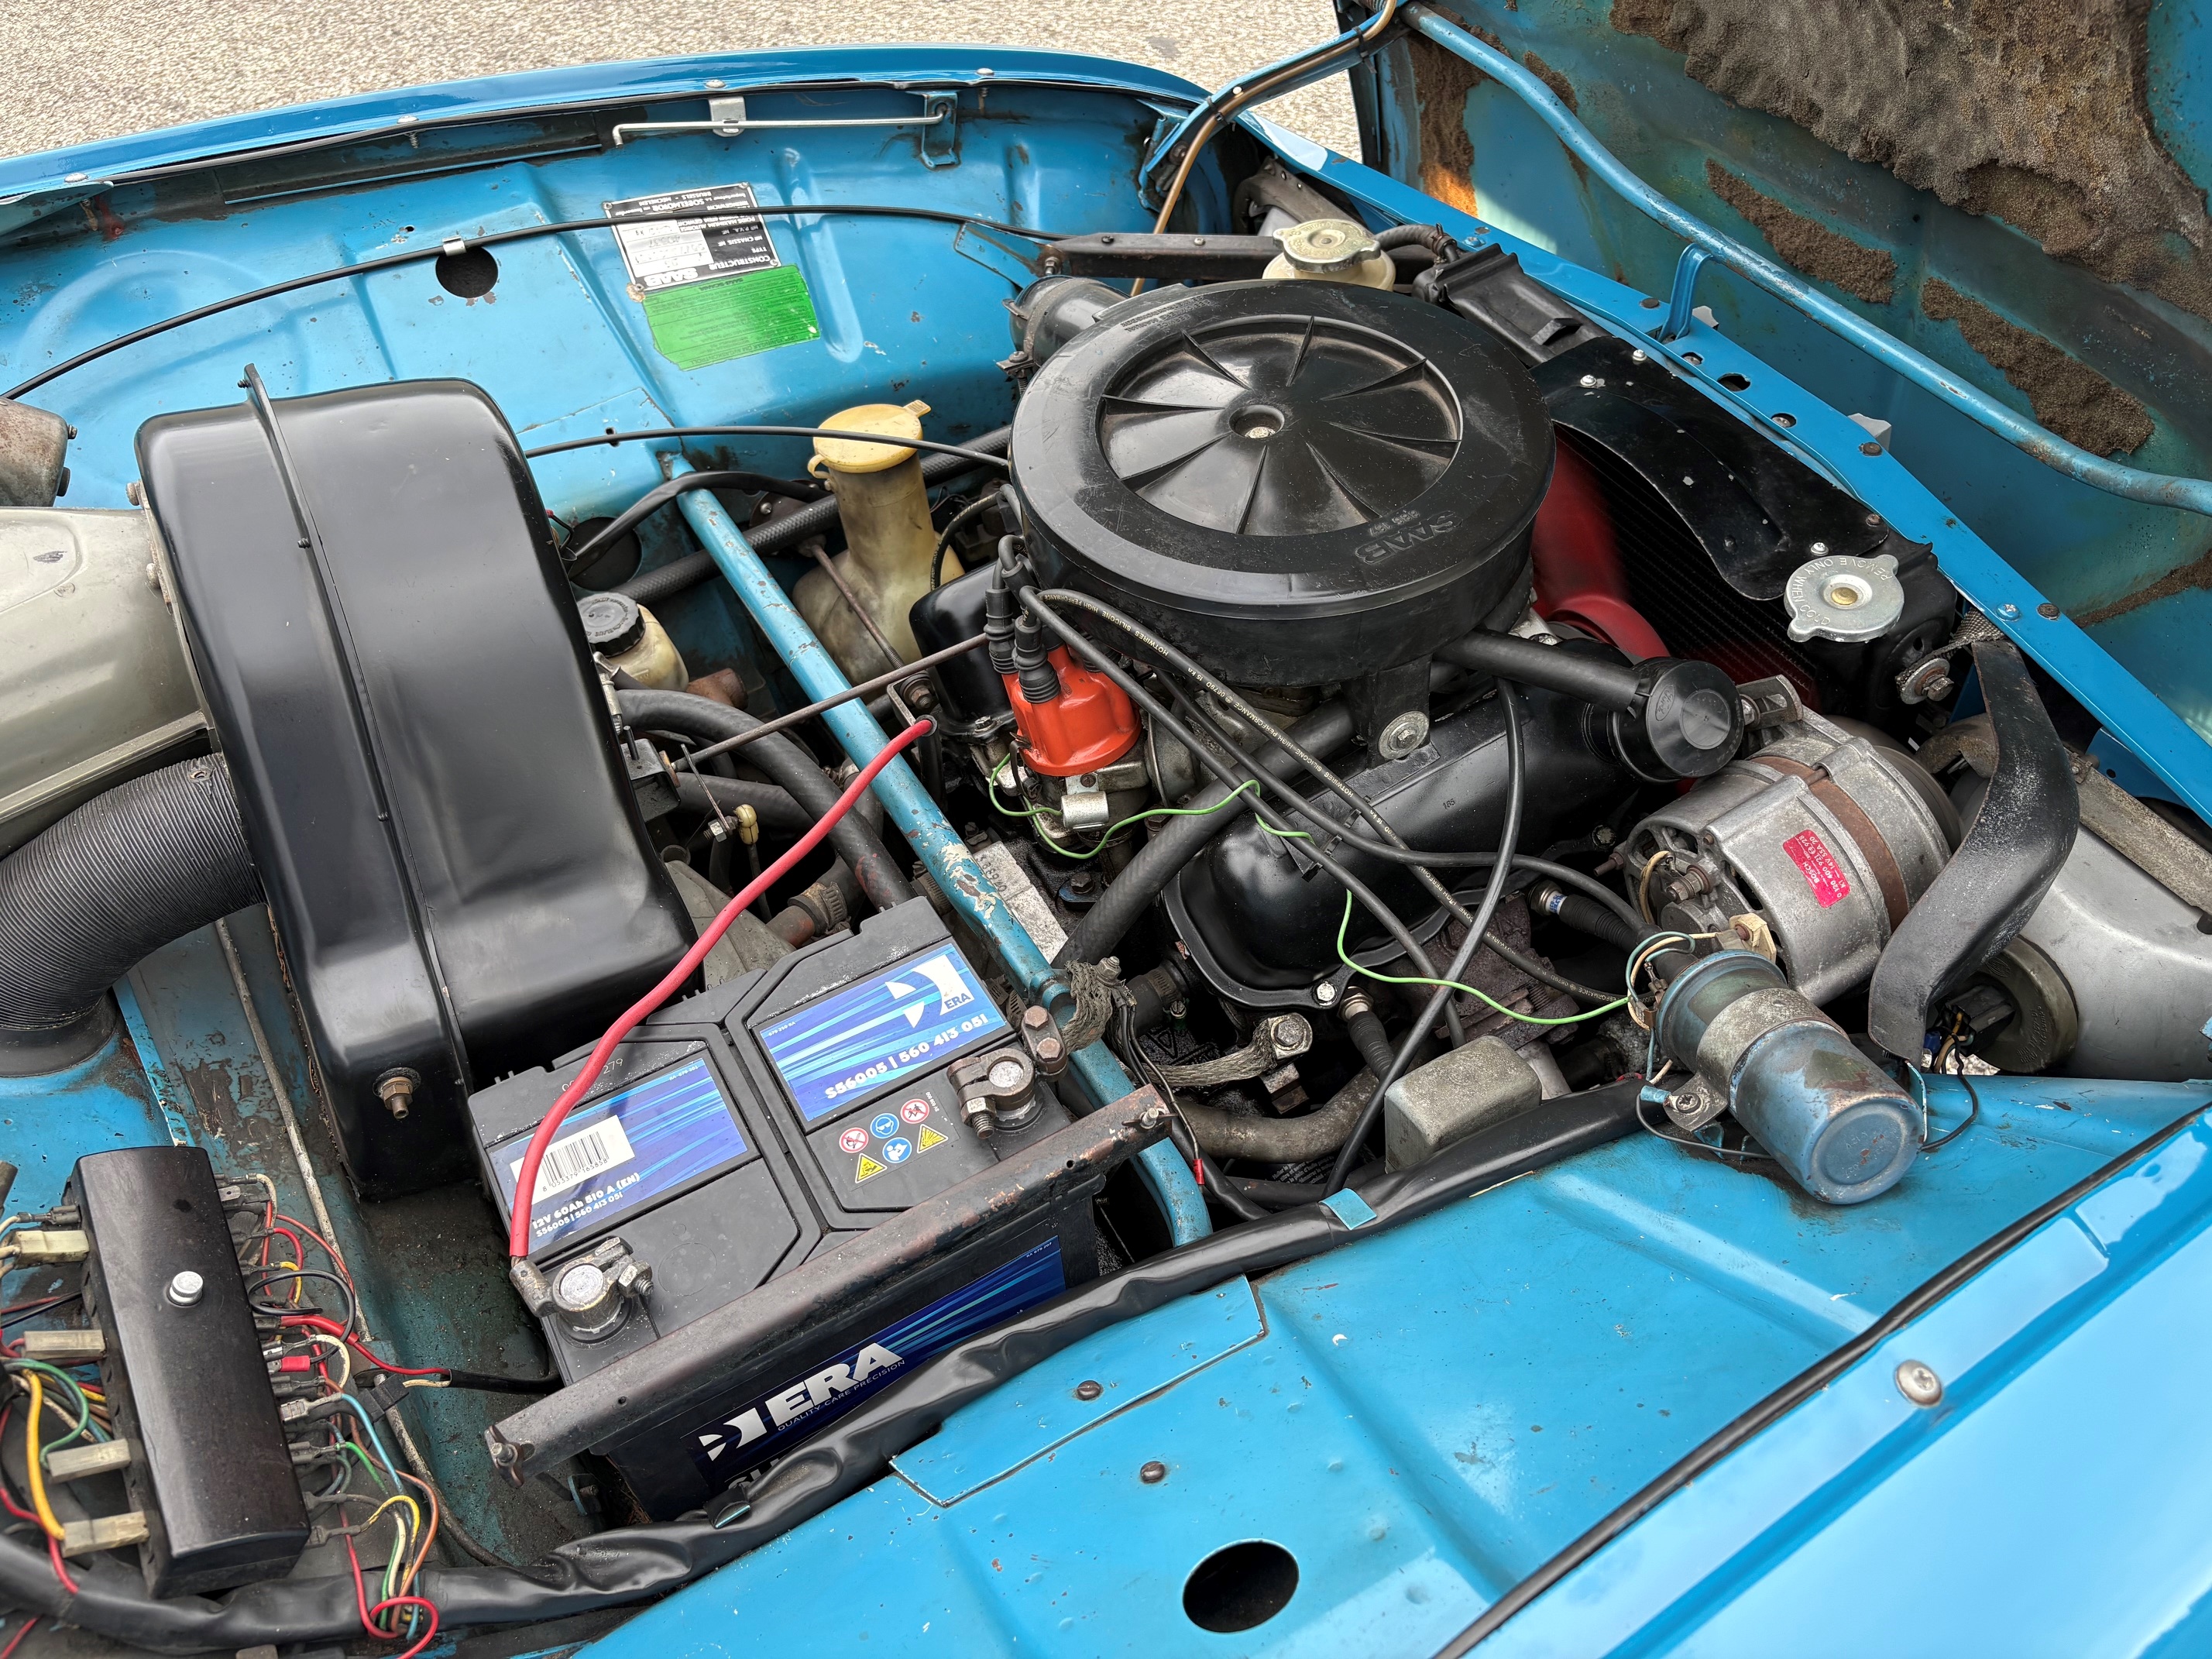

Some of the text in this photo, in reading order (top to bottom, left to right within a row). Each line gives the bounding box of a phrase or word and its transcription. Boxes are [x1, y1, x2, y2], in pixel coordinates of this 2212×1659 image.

[638, 196, 671, 206] MECHELEN
[681, 191, 711, 200] BRUSSELS
[707, 218, 736, 228] MAXIMUM
[727, 235, 754, 245] CHASSIS
[643, 254, 770, 287] CONSTRUCTEUR SAAB
[1124, 318, 1158, 332] MANUAL
[1355, 510, 1463, 564] SAAB
[1790, 556, 1892, 626] REMOVE ONLY WHEN COLD
[1082, 601, 1098, 613] HIGH
[1101, 610, 1132, 631] SILICONE
[1132, 629, 1170, 657] HOTWIRES
[1232, 700, 1279, 738] PERFORMANCE
[1277, 734, 1293, 749] HIGH
[1293, 747, 1323, 772] SILICONE
[1323, 771, 1355, 797] HOTWIRES
[1809, 835, 1818, 844] 20
[1815, 843, 1827, 857] 55A
[1802, 860, 1819, 883] BOSCH
[1822, 865, 1832, 880] 400
[1825, 857, 1835, 869] 14V
[1829, 879, 1839, 892] 120
[943, 991, 971, 1010] ERA
[601, 1057, 624, 1074] 279
[824, 1060, 888, 1100] S56005
[898, 1040, 931, 1063] 560
[930, 1025, 959, 1046] 413
[960, 1012, 988, 1033] 051
[531, 1171, 641, 1229] 12V 60Ah 510 A (EN)
[534, 1216, 570, 1237] S56005
[573, 1204, 593, 1218] 560
[591, 1197, 608, 1211] 413
[606, 1190, 623, 1203] 051
[764, 1338, 903, 1427] ERA
[777, 1358, 906, 1432] QUALITY CARE PRECISION
